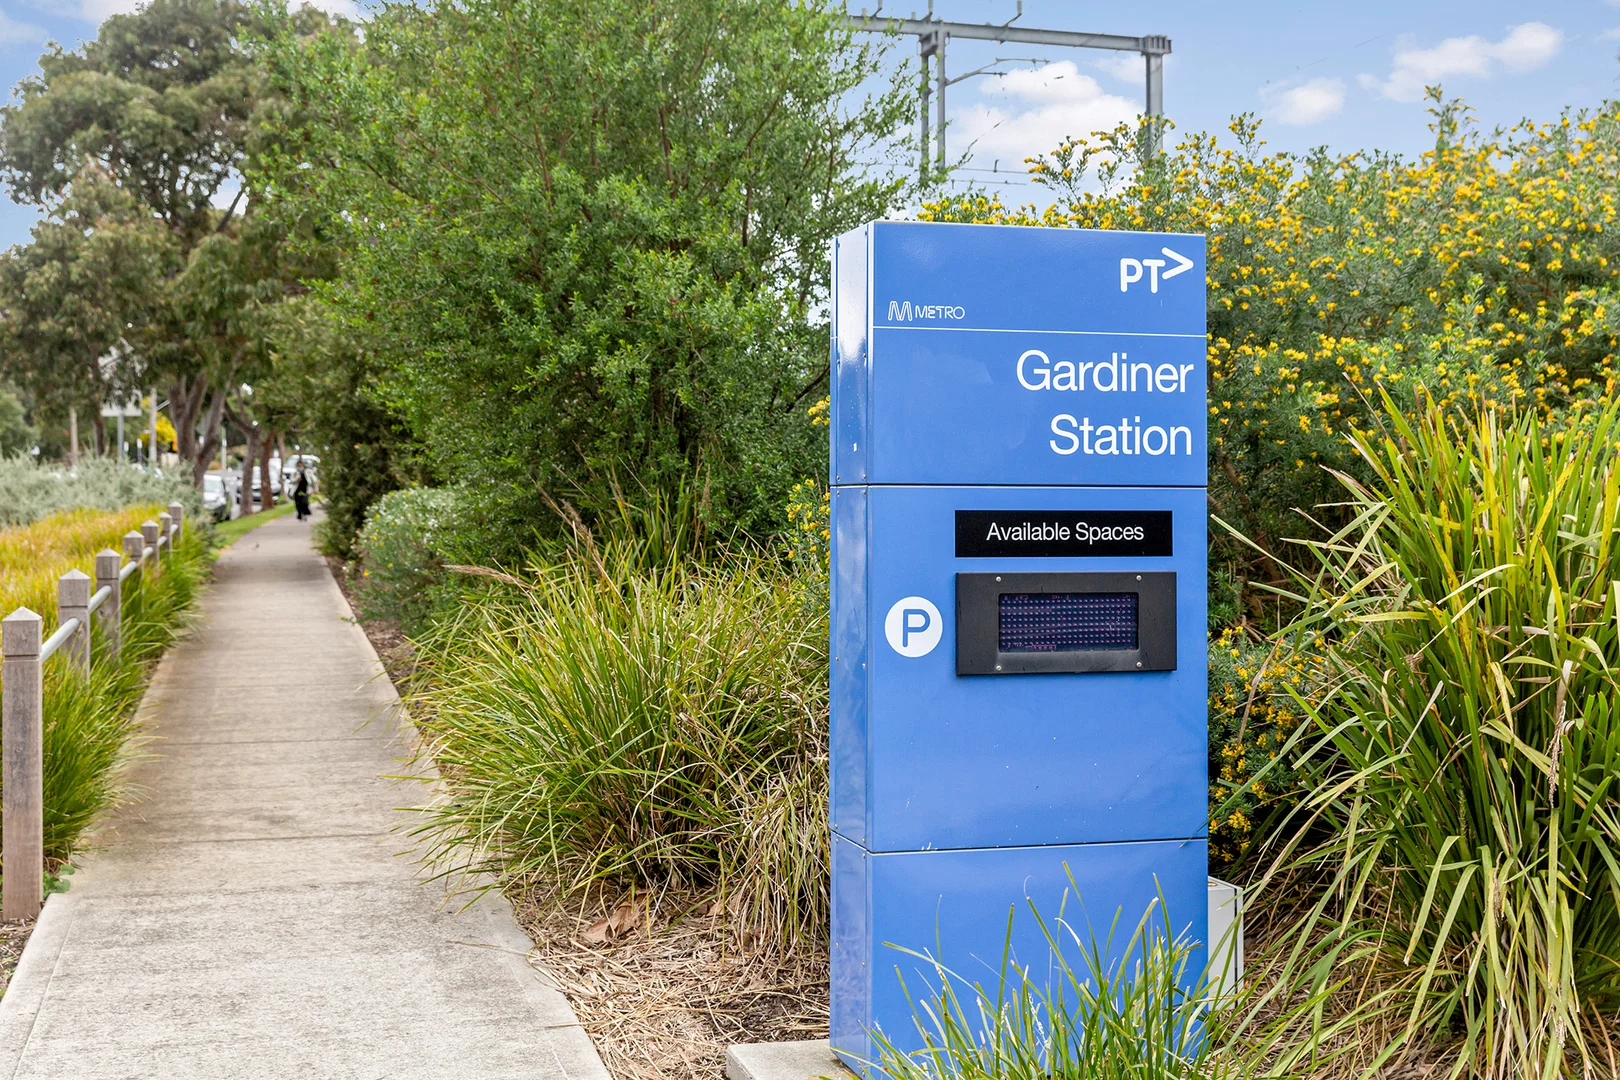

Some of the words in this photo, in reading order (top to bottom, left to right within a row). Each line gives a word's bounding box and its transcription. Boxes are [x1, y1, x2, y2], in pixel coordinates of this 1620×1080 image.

[915, 305, 965, 320] METRO
[1016, 349, 1195, 393] Gardiner
[1050, 413, 1192, 456] Station
[986, 522, 1071, 541] Available
[1075, 522, 1144, 545] Spaces
[902, 608, 931, 648] P
